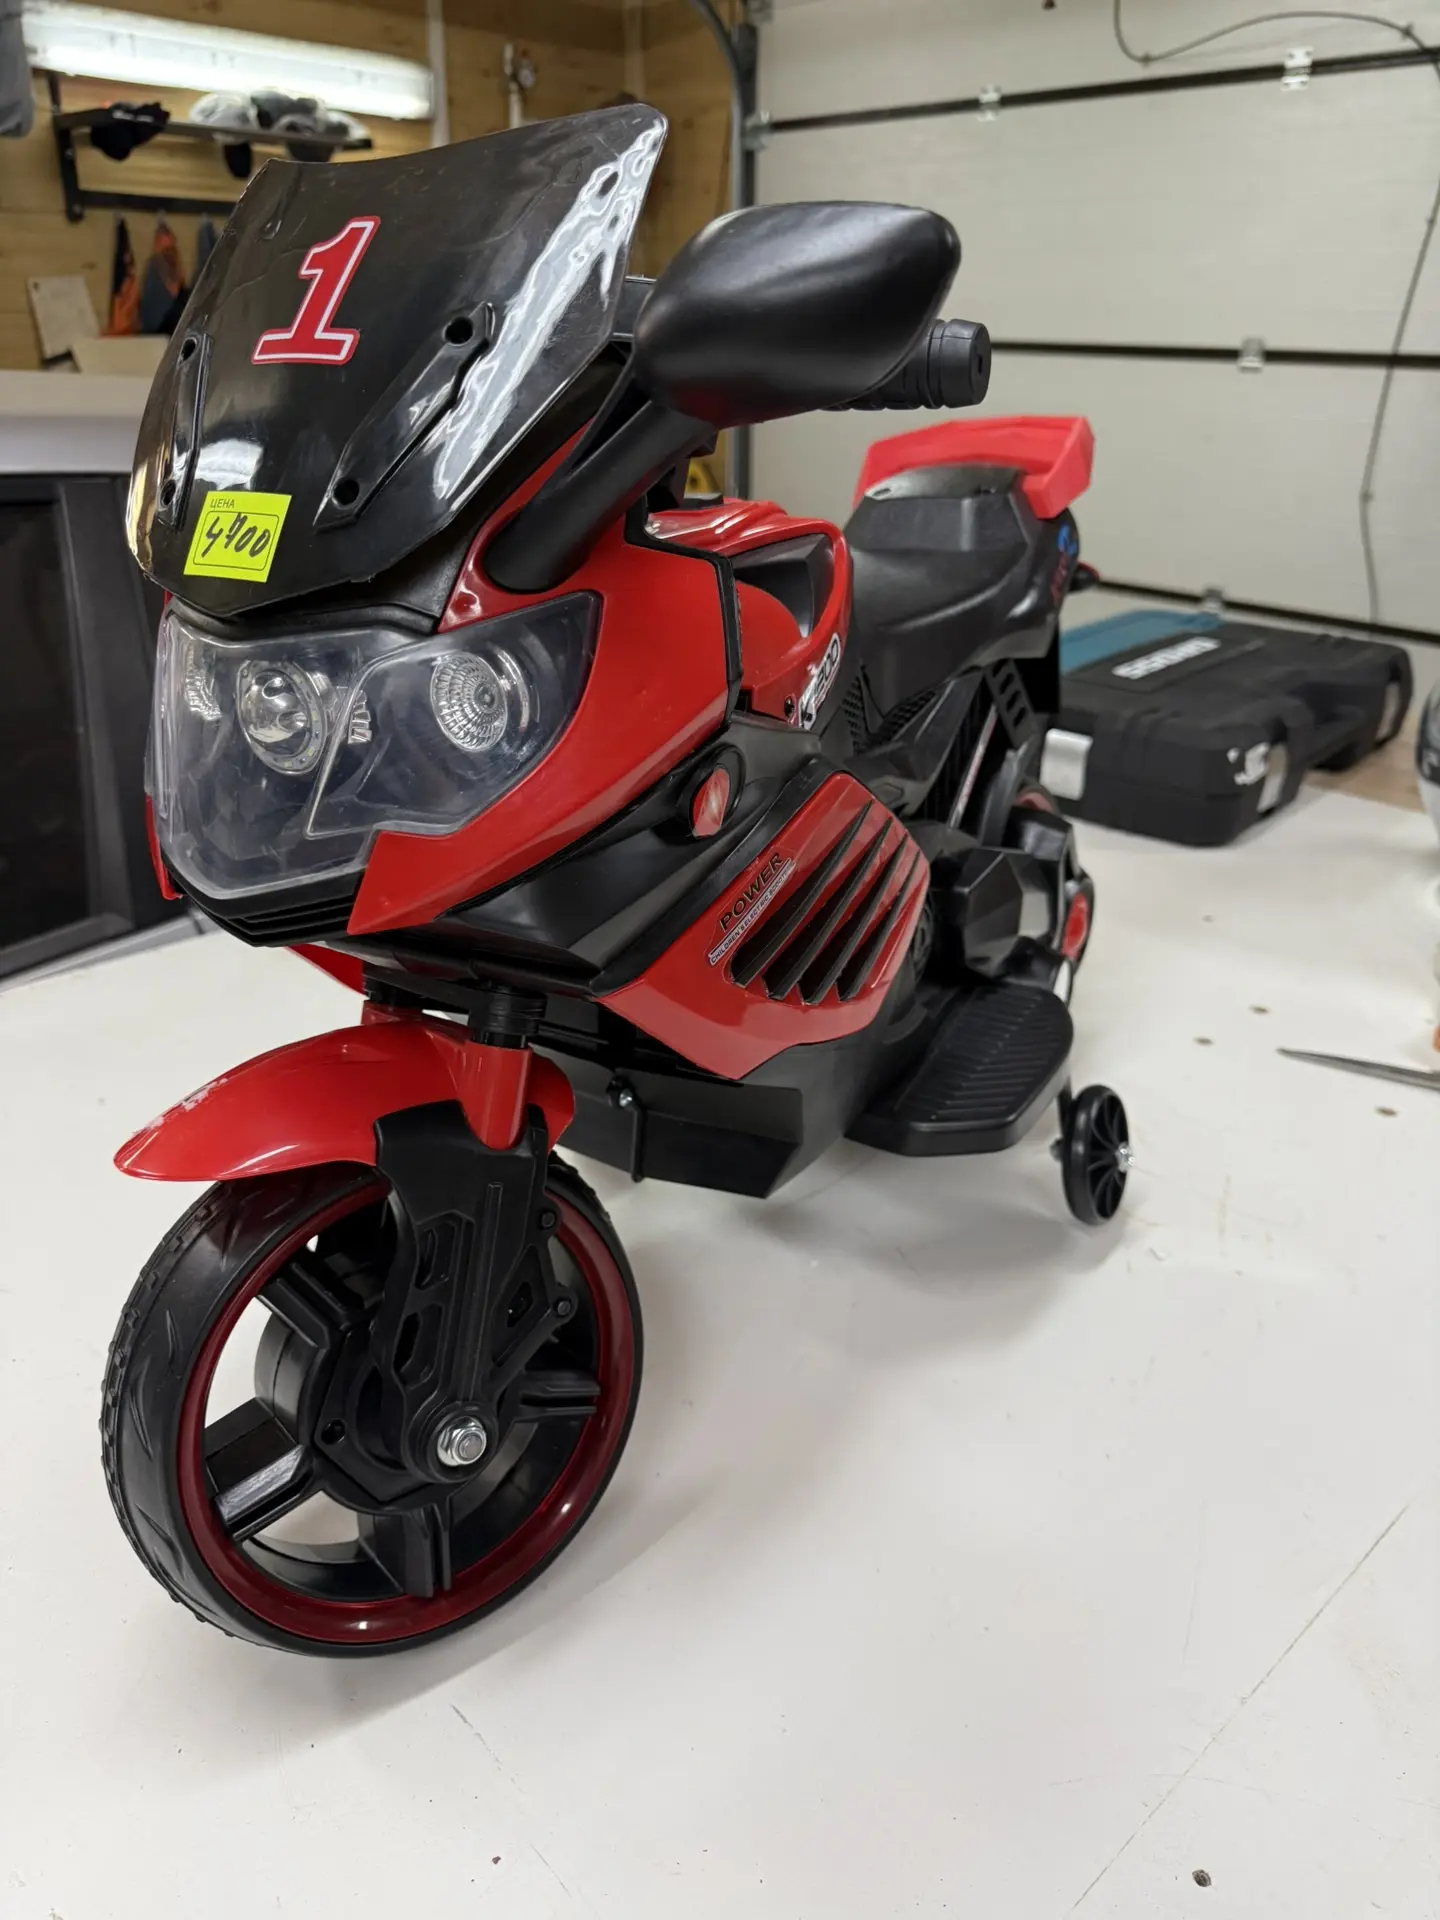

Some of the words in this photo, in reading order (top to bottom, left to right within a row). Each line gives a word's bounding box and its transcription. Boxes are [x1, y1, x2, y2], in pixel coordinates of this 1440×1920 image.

[252, 216, 381, 364] 1
[210, 498, 235, 511] ЦЕНА
[719, 852, 783, 933] POWER
[743, 894, 769, 926] ELECTRIC
